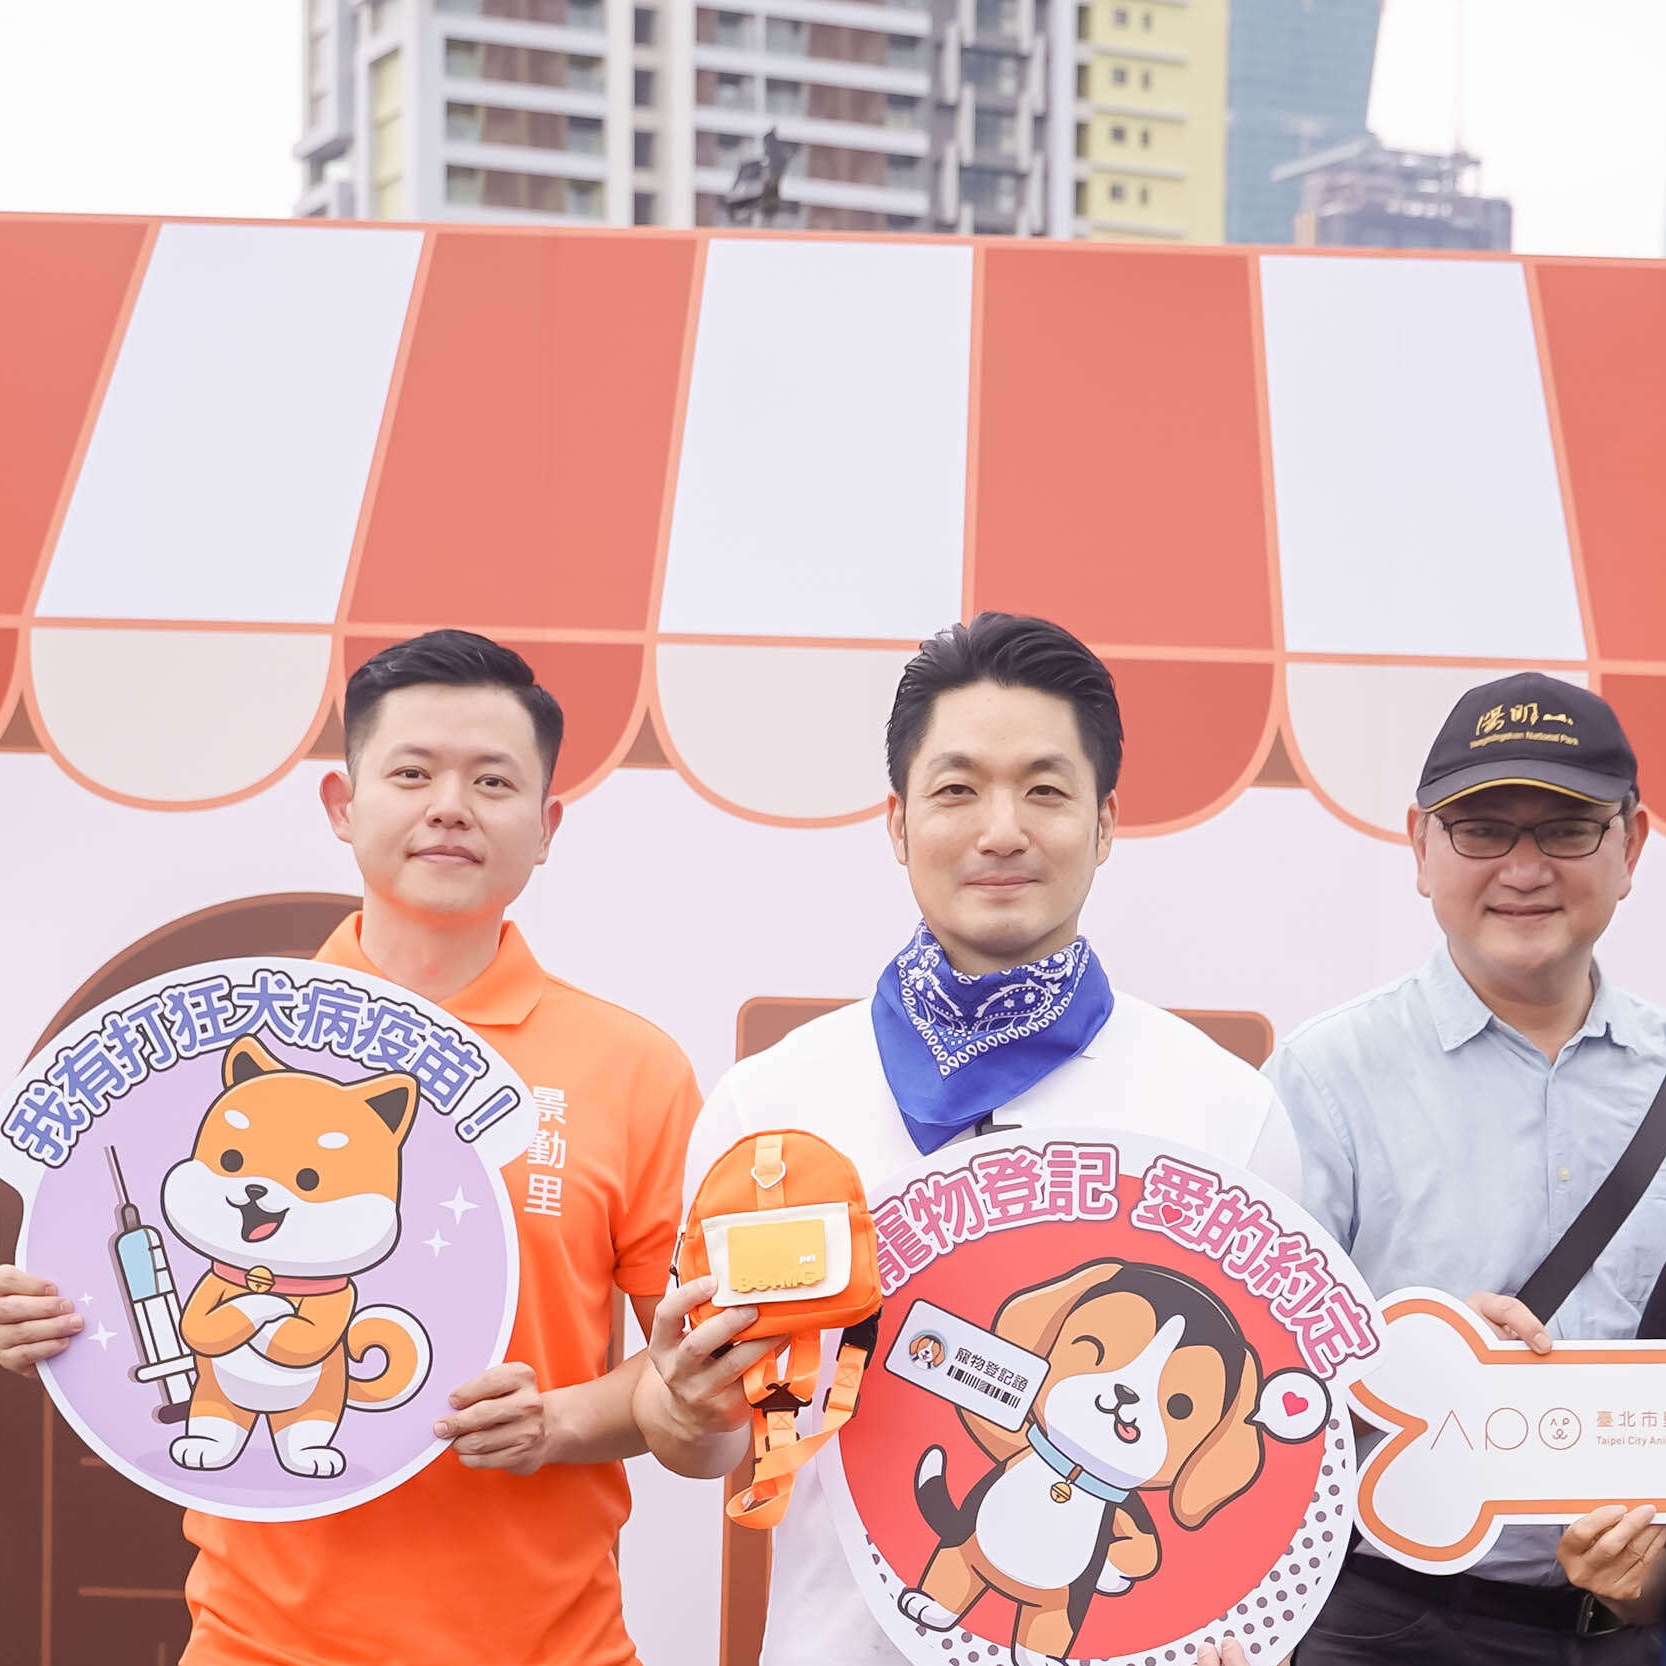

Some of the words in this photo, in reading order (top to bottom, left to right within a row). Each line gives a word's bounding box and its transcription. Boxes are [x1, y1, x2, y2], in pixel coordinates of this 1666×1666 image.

[523, 1085, 569, 1217] 景勤里
[874, 1149, 1114, 1290] 寵物登記
[1136, 1161, 1375, 1376] 愛的約定
[954, 1347, 1029, 1393] 寵物登記證
[1596, 1435, 1625, 1446] Taipei
[1628, 1435, 1647, 1447] City
